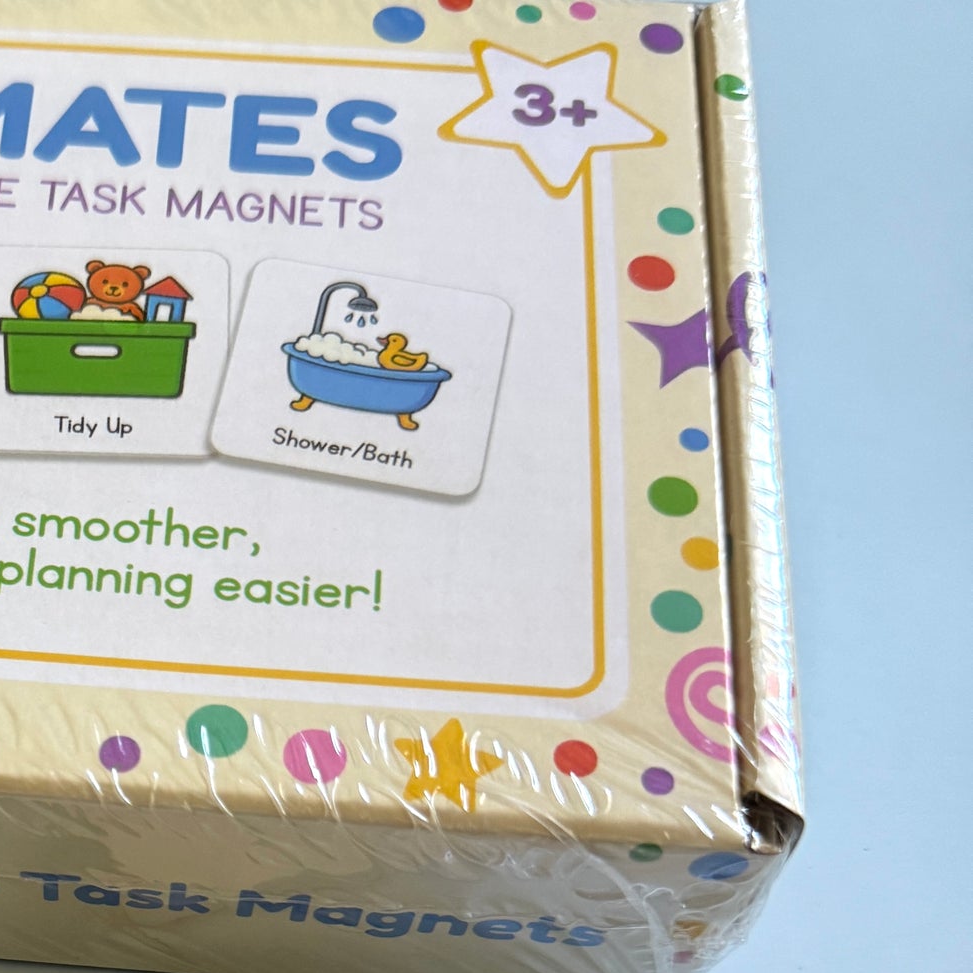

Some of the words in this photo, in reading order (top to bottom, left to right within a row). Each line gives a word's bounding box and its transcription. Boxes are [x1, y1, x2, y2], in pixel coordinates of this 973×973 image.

[512, 83, 598, 128] 3+
[40, 180, 147, 215] TASK
[165, 187, 384, 231] MAGNETS
[54, 415, 98, 440] Tidy
[106, 416, 133, 440] Up
[272, 427, 413, 470] Shower/Bath
[12, 506, 261, 557] smoother,
[213, 569, 382, 612] easier!
[20, 870, 211, 917] Task
[236, 888, 607, 949] Magnets
